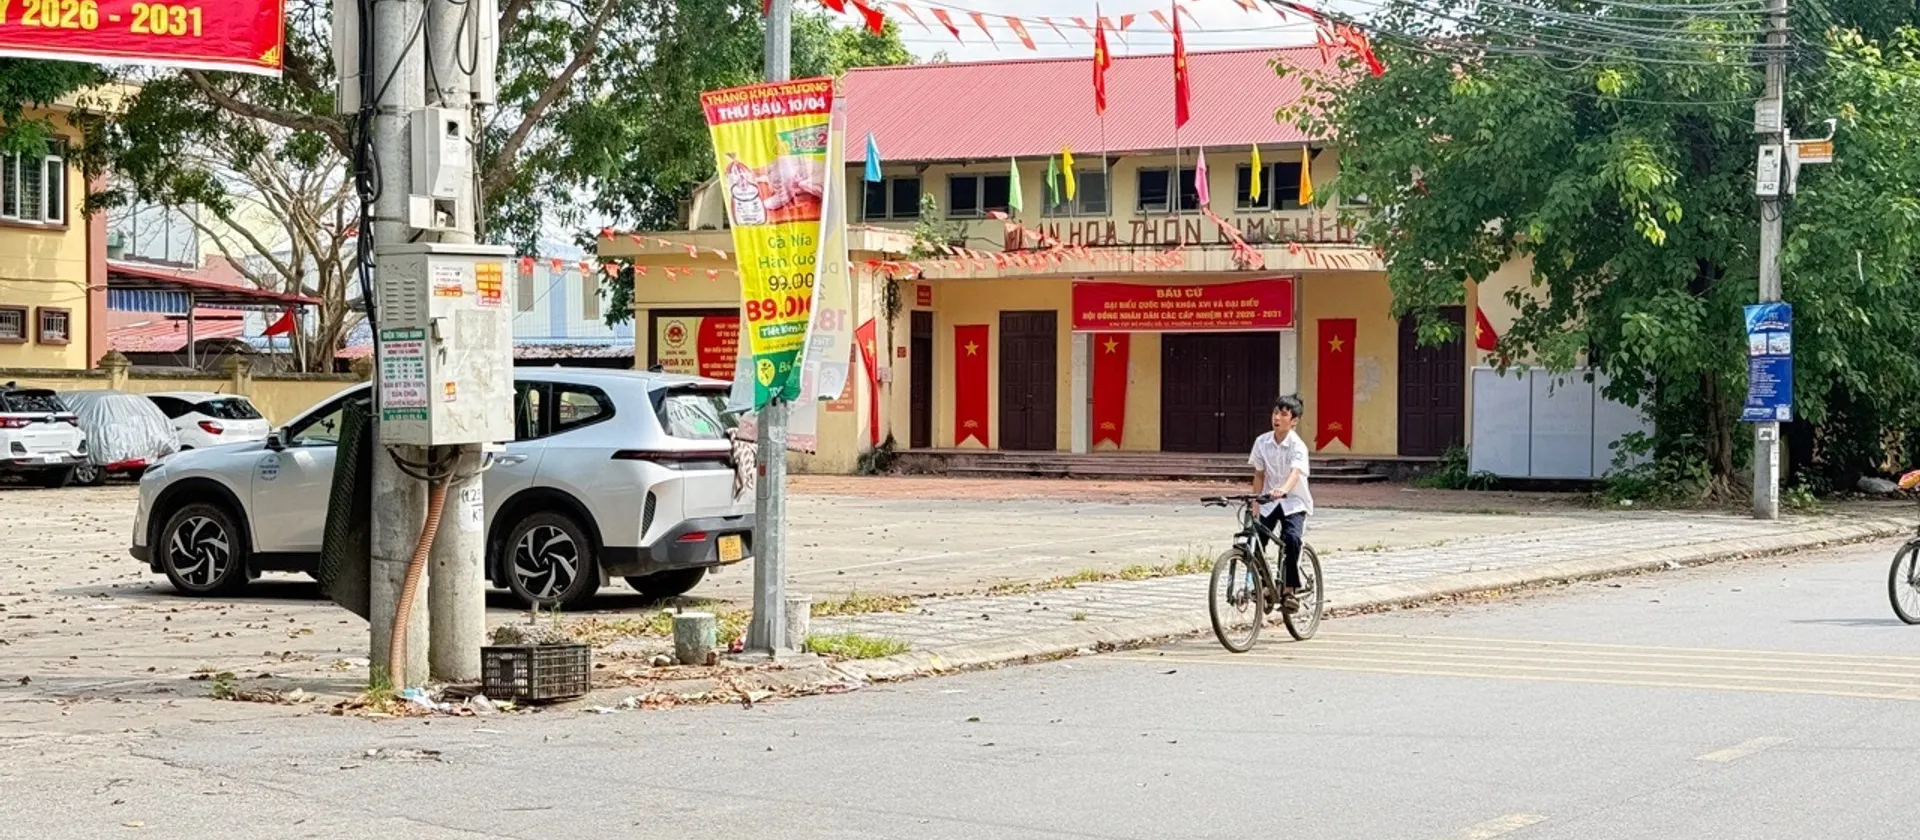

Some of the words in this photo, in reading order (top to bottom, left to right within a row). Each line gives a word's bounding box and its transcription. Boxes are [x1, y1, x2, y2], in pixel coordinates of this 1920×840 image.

[21, 0, 99, 30] 2026
[130, 3, 202, 36] 2031
[706, 91, 748, 105] THÁNG
[749, 87, 779, 102] KHAI
[718, 101, 749, 120] THỨ
[788, 97, 826, 111] 10/04
